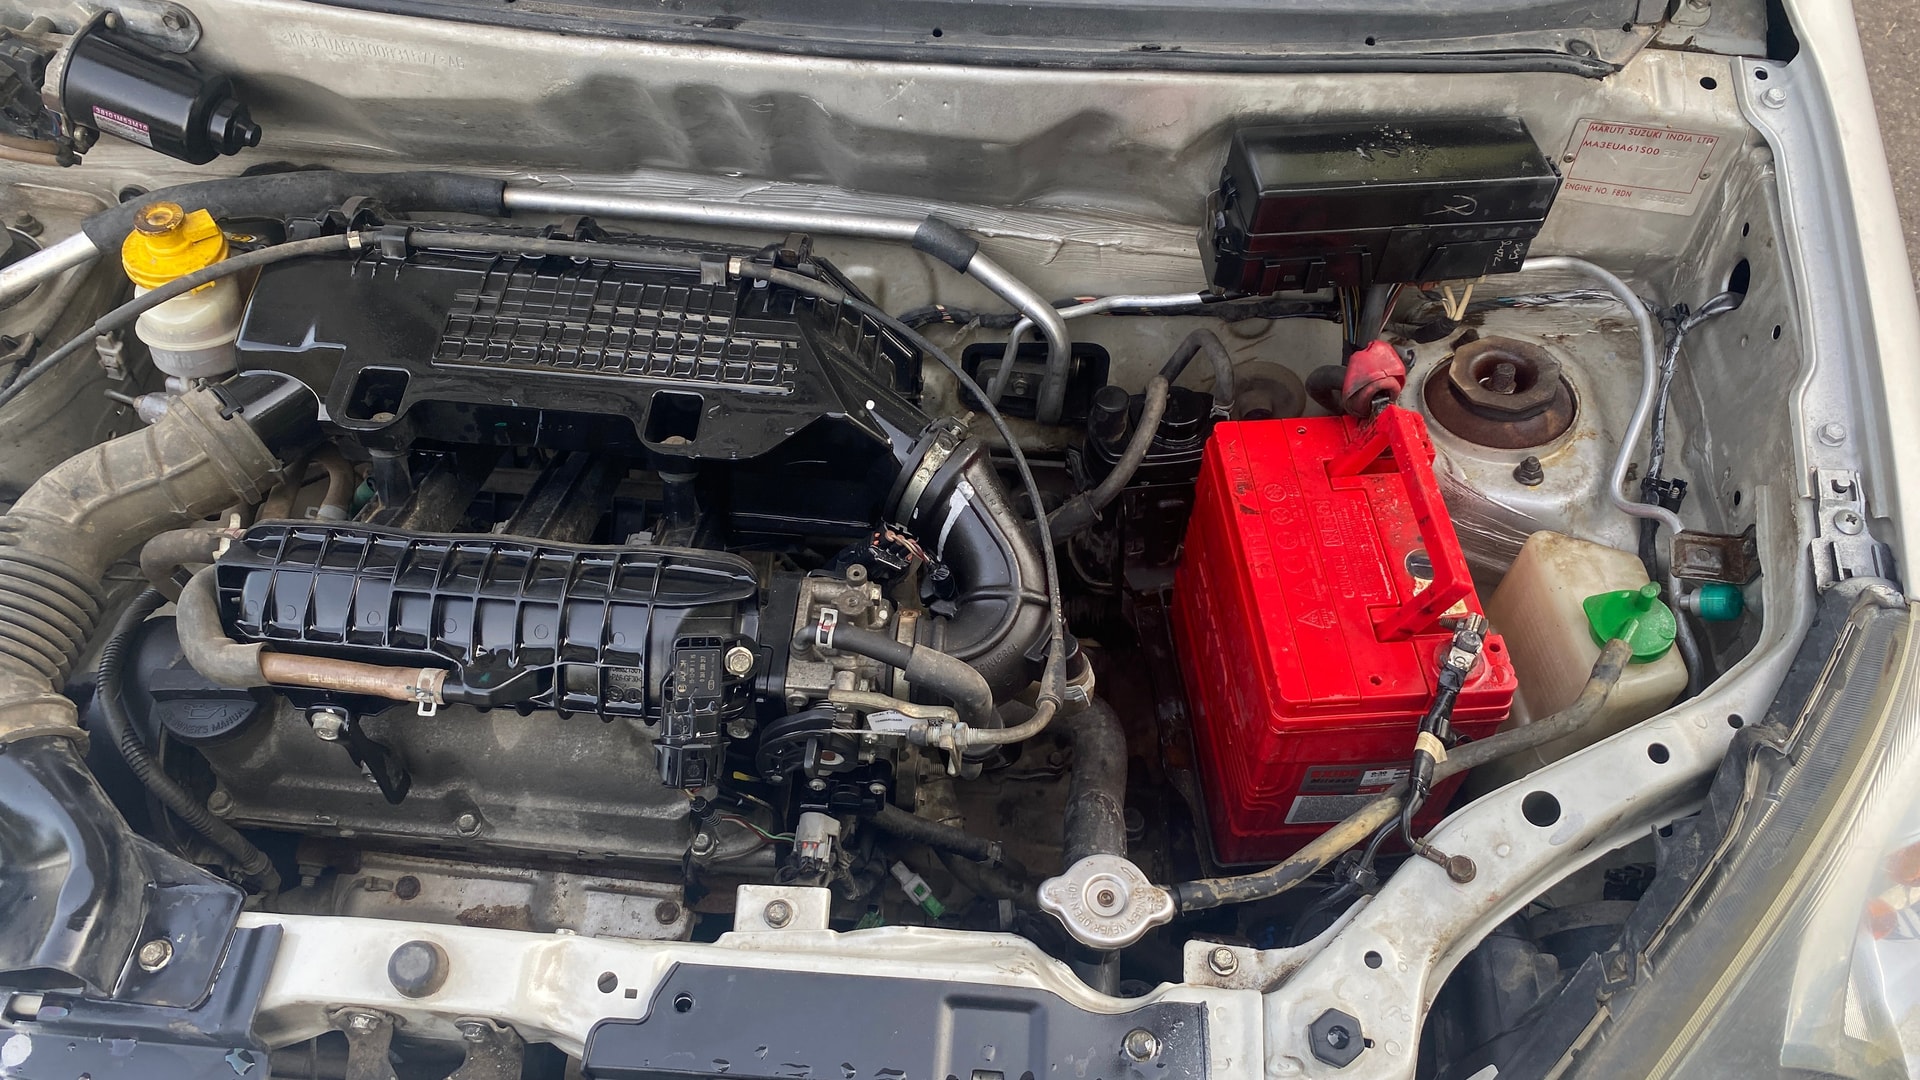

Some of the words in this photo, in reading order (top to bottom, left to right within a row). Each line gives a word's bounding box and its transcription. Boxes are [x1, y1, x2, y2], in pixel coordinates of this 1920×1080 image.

[1589, 124, 1625, 134] MARUTI
[1628, 128, 1662, 139] SUZUKI
[1665, 133, 1693, 143] INDIA
[1582, 139, 1660, 156] MA3EUA61S00
[1564, 182, 1592, 193] ENGINE
[1611, 188, 1633, 198] F8DN
[211, 706, 250, 731] MANUAL
[1070, 902, 1092, 928] OPEN
[1128, 886, 1146, 926] DANGER
[1093, 923, 1128, 937] NEVER
